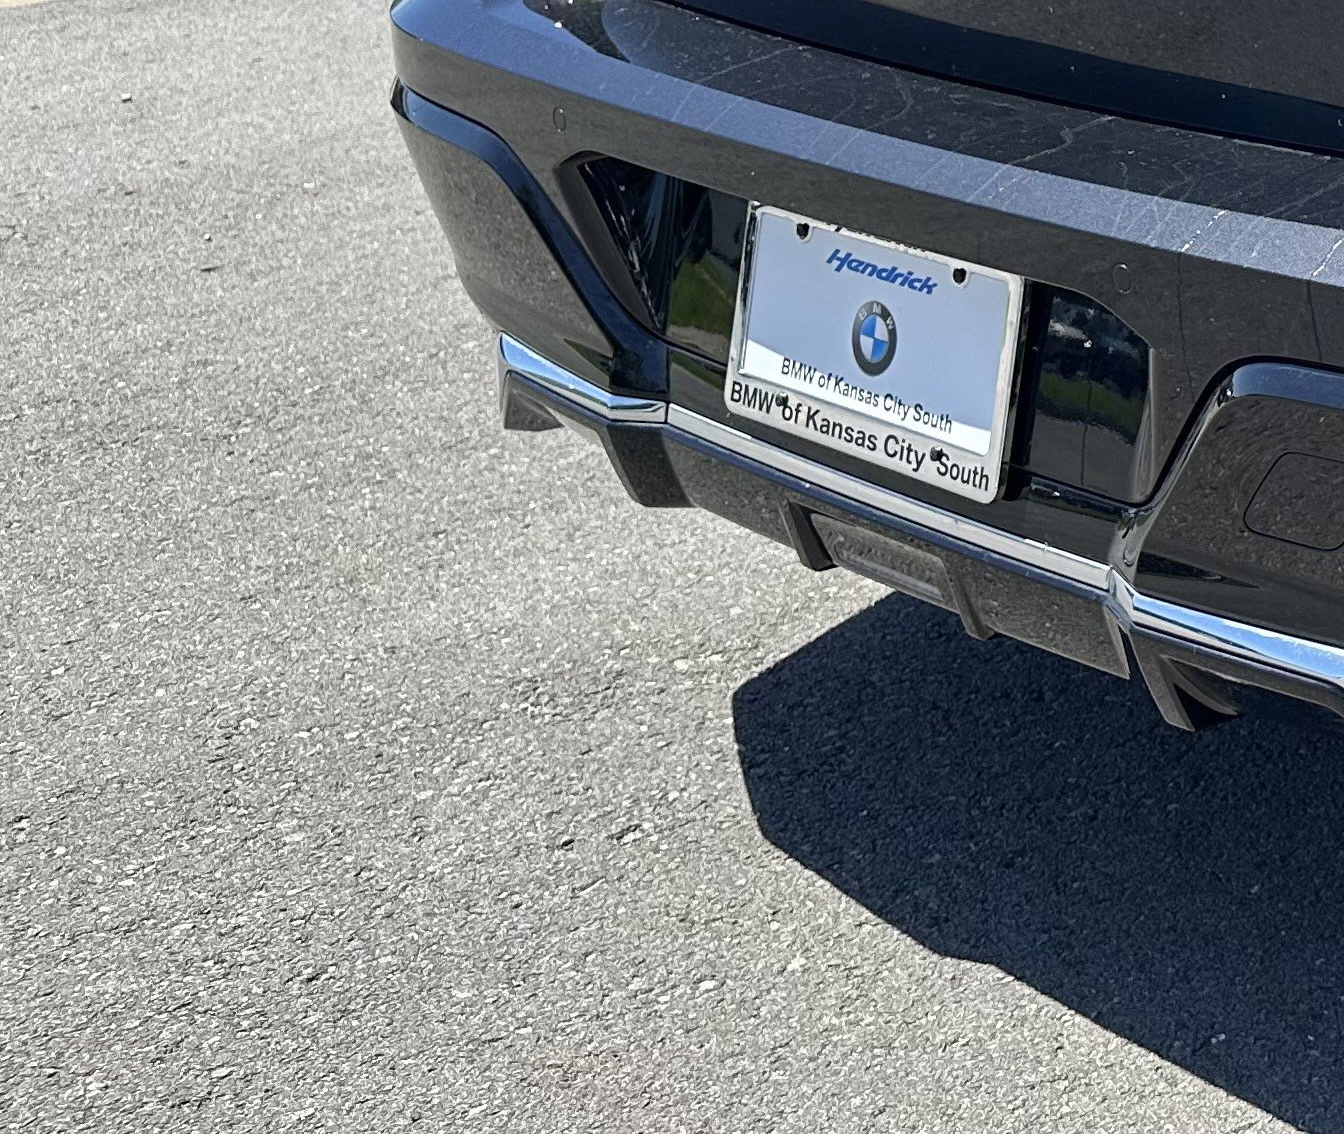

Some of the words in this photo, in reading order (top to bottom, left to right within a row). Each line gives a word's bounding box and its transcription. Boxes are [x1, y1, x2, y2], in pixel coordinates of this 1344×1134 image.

[826, 248, 938, 295] Hendrick
[781, 356, 817, 384] BMW
[818, 372, 833, 390] of
[834, 375, 880, 407] Kansas
[883, 393, 911, 421] City
[913, 403, 953, 434] South
[730, 380, 775, 414] BMW
[781, 402, 803, 424] of
[805, 406, 879, 452] Kansas
[884, 434, 926, 472] City
[936, 448, 990, 491] South
